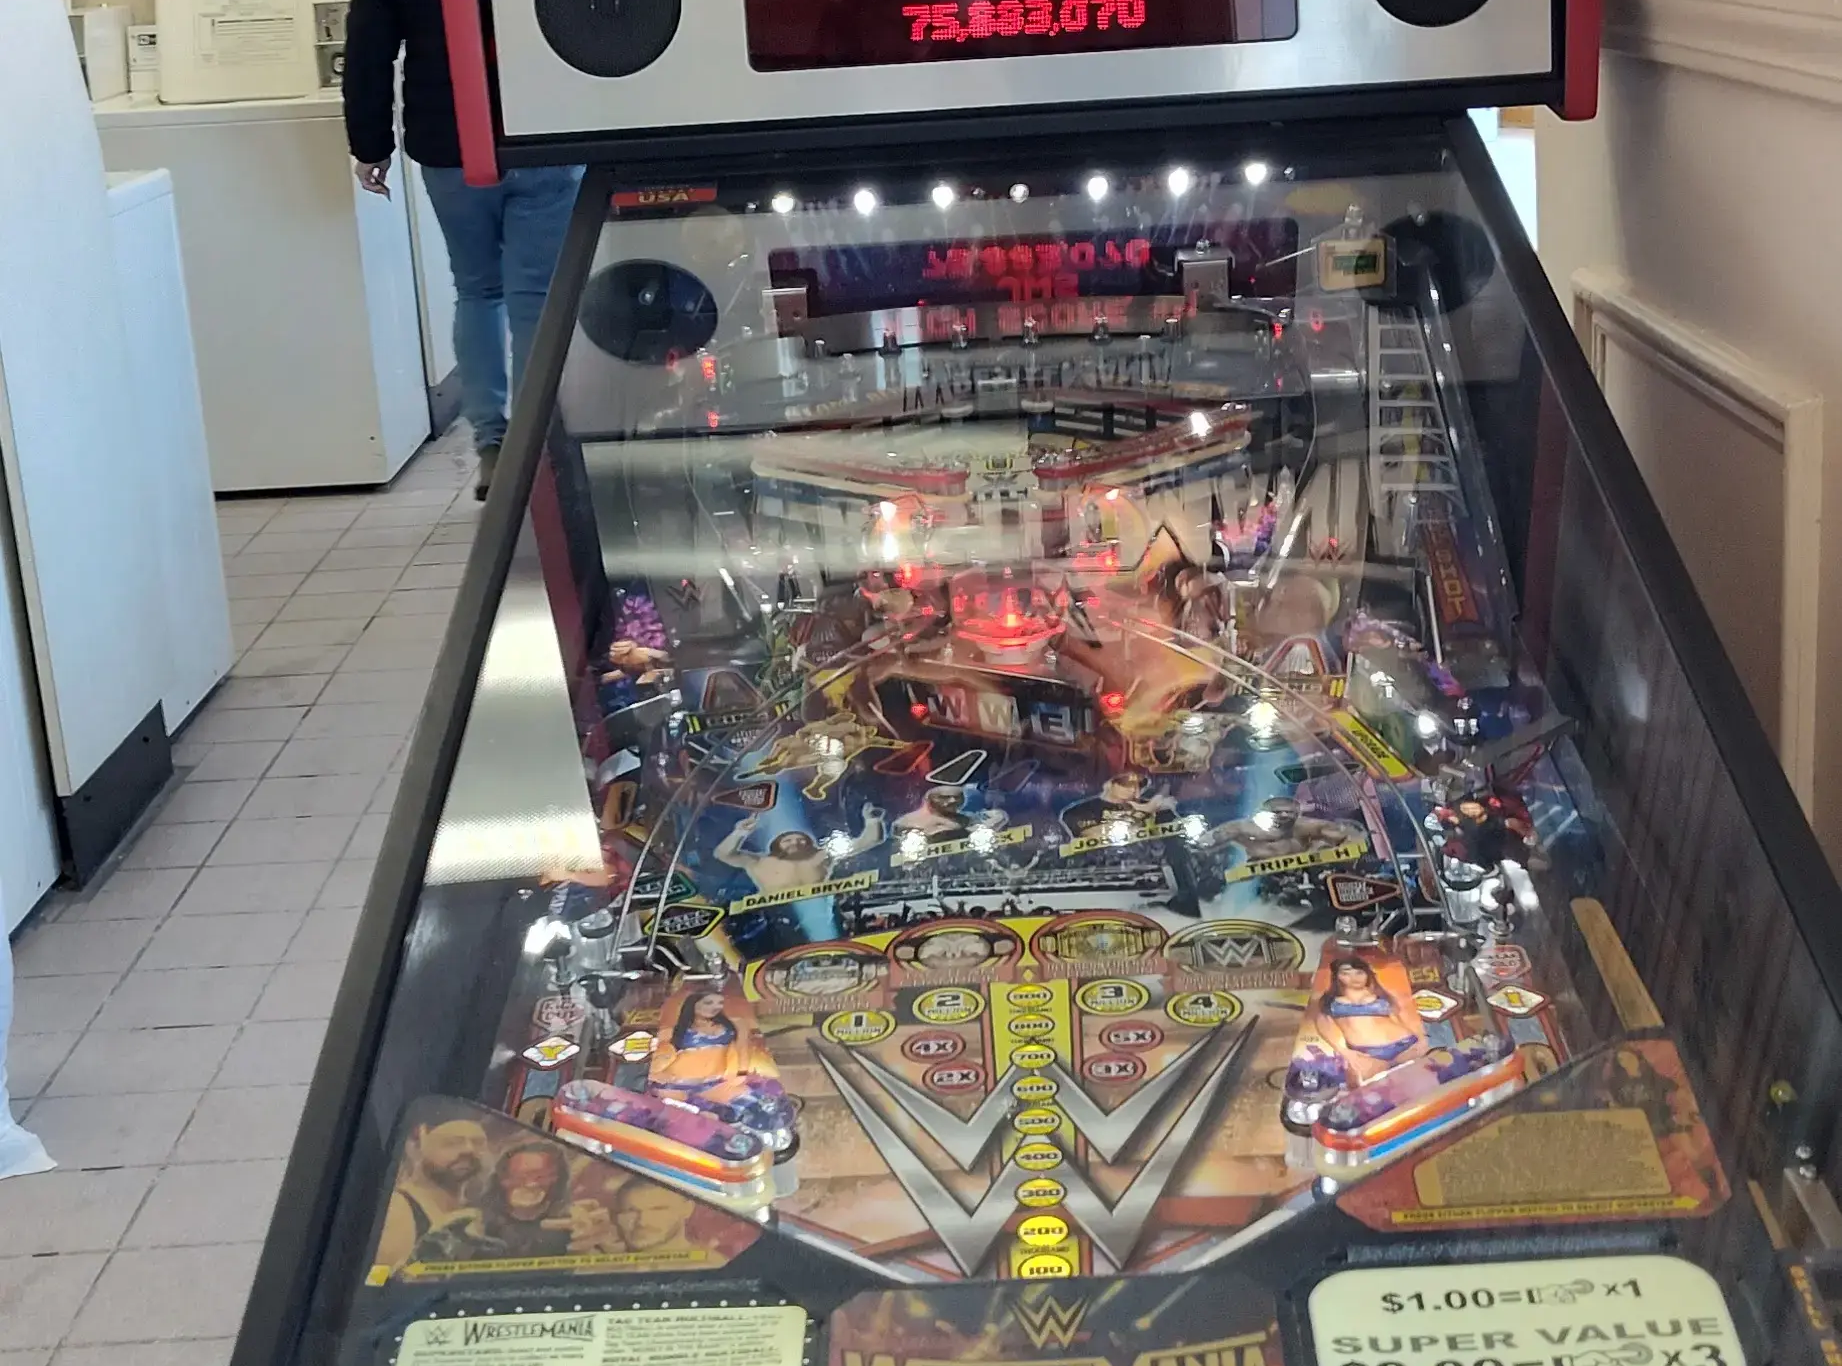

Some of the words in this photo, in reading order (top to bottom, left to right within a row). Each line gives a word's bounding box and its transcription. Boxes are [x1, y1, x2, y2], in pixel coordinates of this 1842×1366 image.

[638, 190, 690, 204] USA
[960, 831, 1014, 851] RK
[1074, 834, 1128, 850] JO
[1245, 852, 1321, 875] TRIPLE
[1334, 847, 1351, 860] H
[745, 889, 802, 908] DANIEL
[811, 878, 865, 896] BRYAN
[1101, 985, 1123, 999] 3
[935, 994, 962, 1008] 2
[1189, 995, 1213, 1008] 4
[913, 1040, 950, 1054] 4X
[1020, 1152, 1060, 1161] 400
[1022, 1188, 1061, 1198] 300
[1023, 1226, 1065, 1236] 200
[1028, 1265, 1063, 1276] 100
[1331, 1329, 1519, 1354] SUPER
[1534, 1316, 1725, 1346] VALUE
